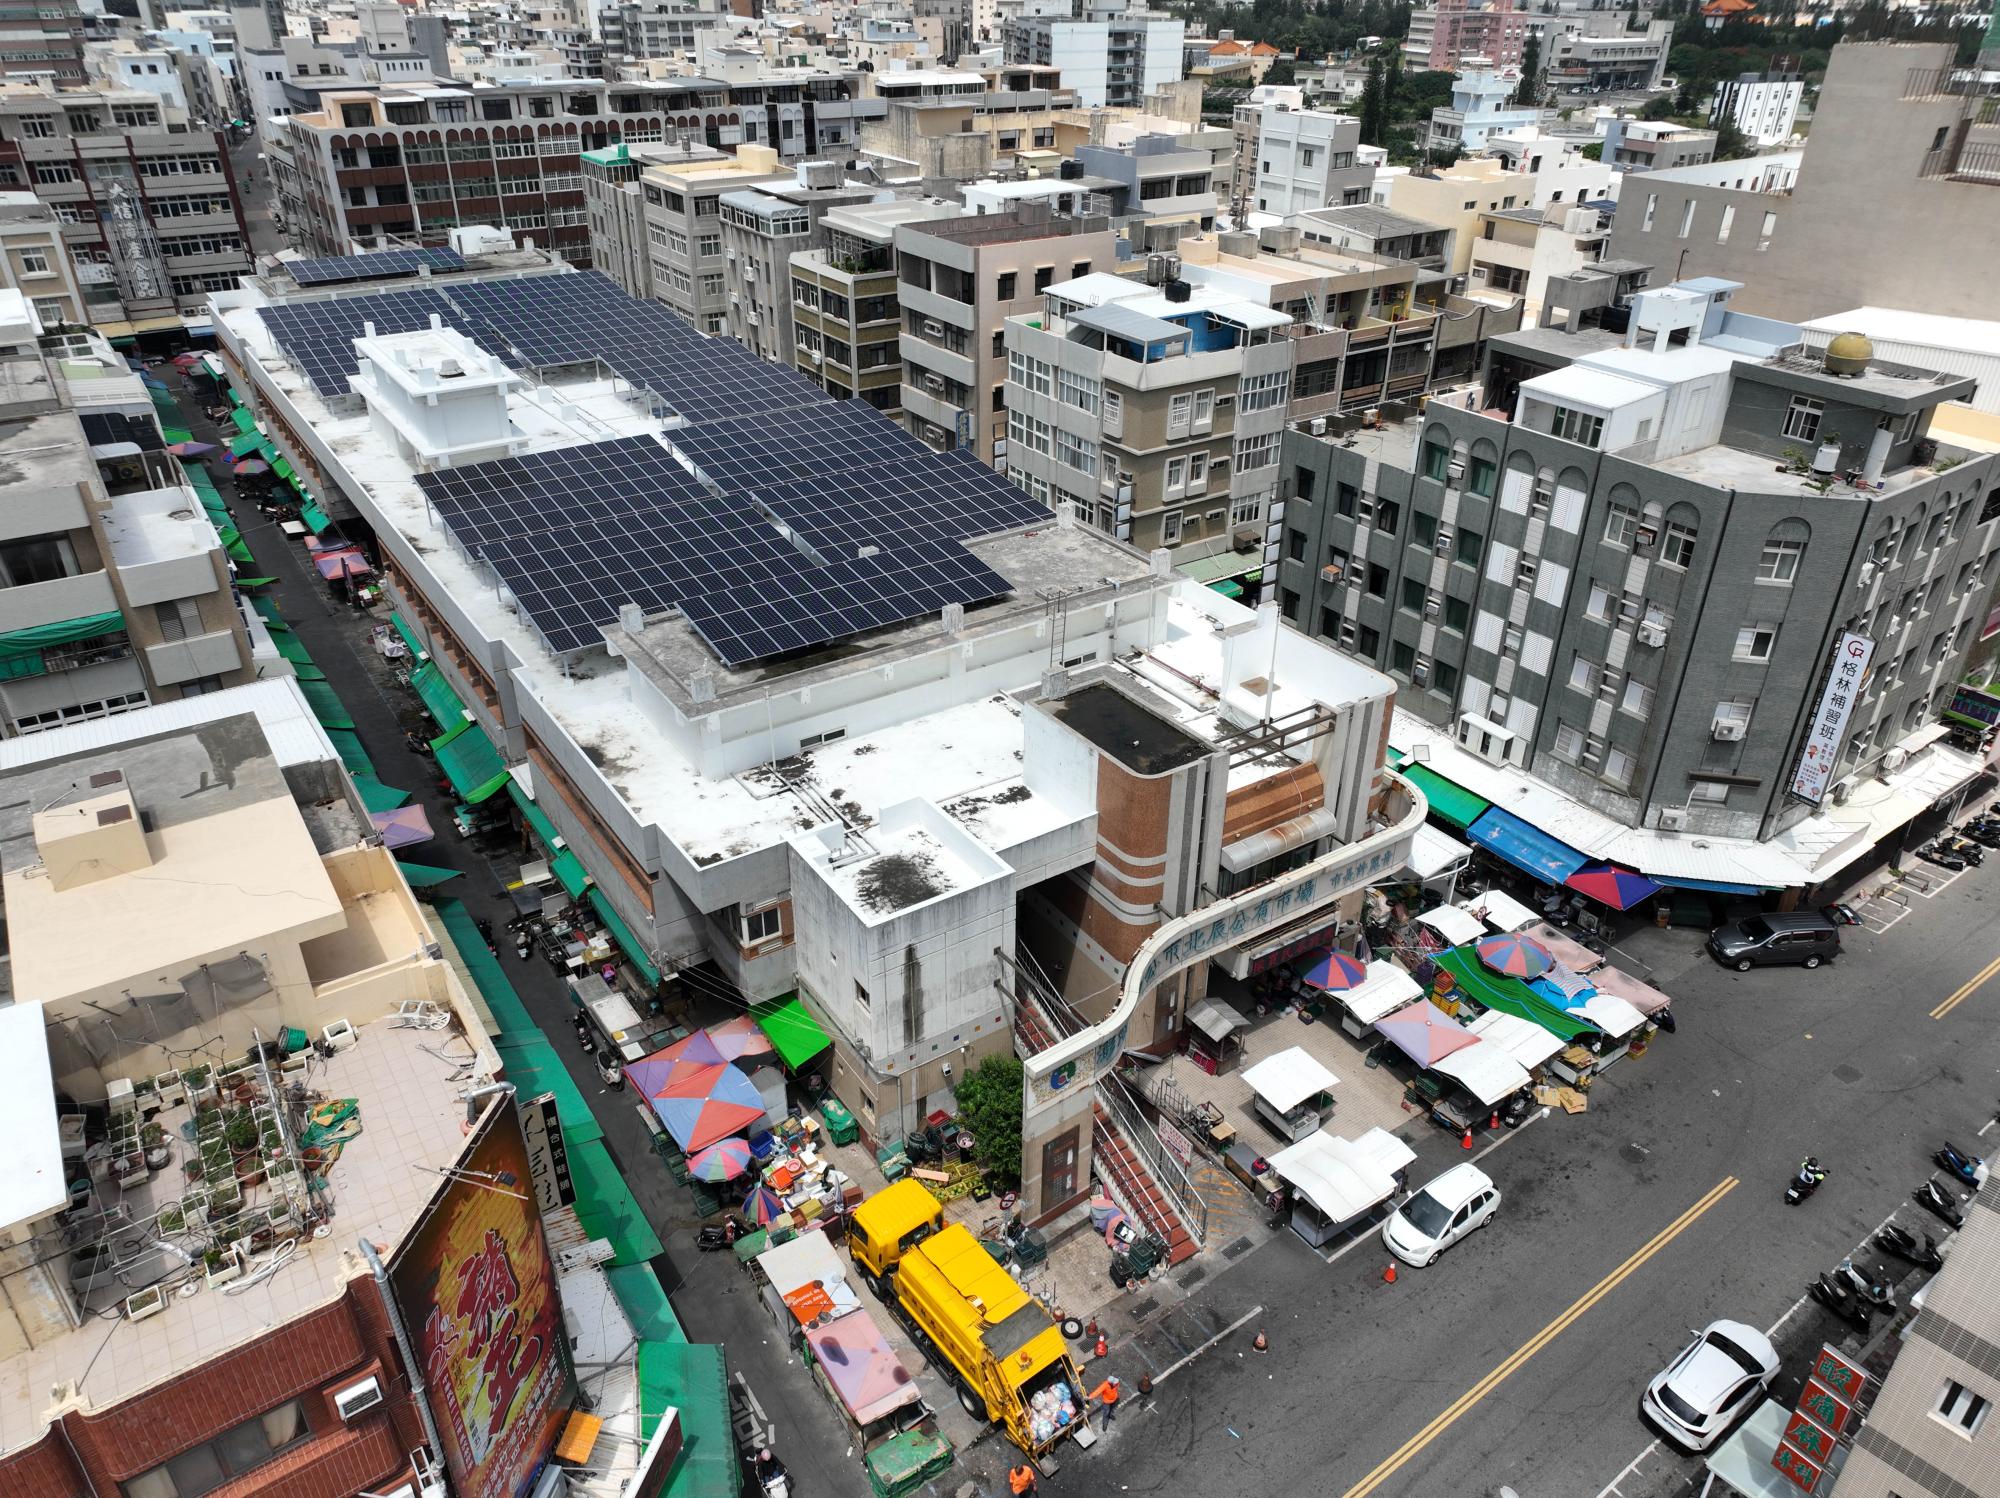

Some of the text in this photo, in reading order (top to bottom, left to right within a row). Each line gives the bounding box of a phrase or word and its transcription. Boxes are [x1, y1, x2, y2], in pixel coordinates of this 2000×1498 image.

[1818, 659, 1859, 742] 格林補習班
